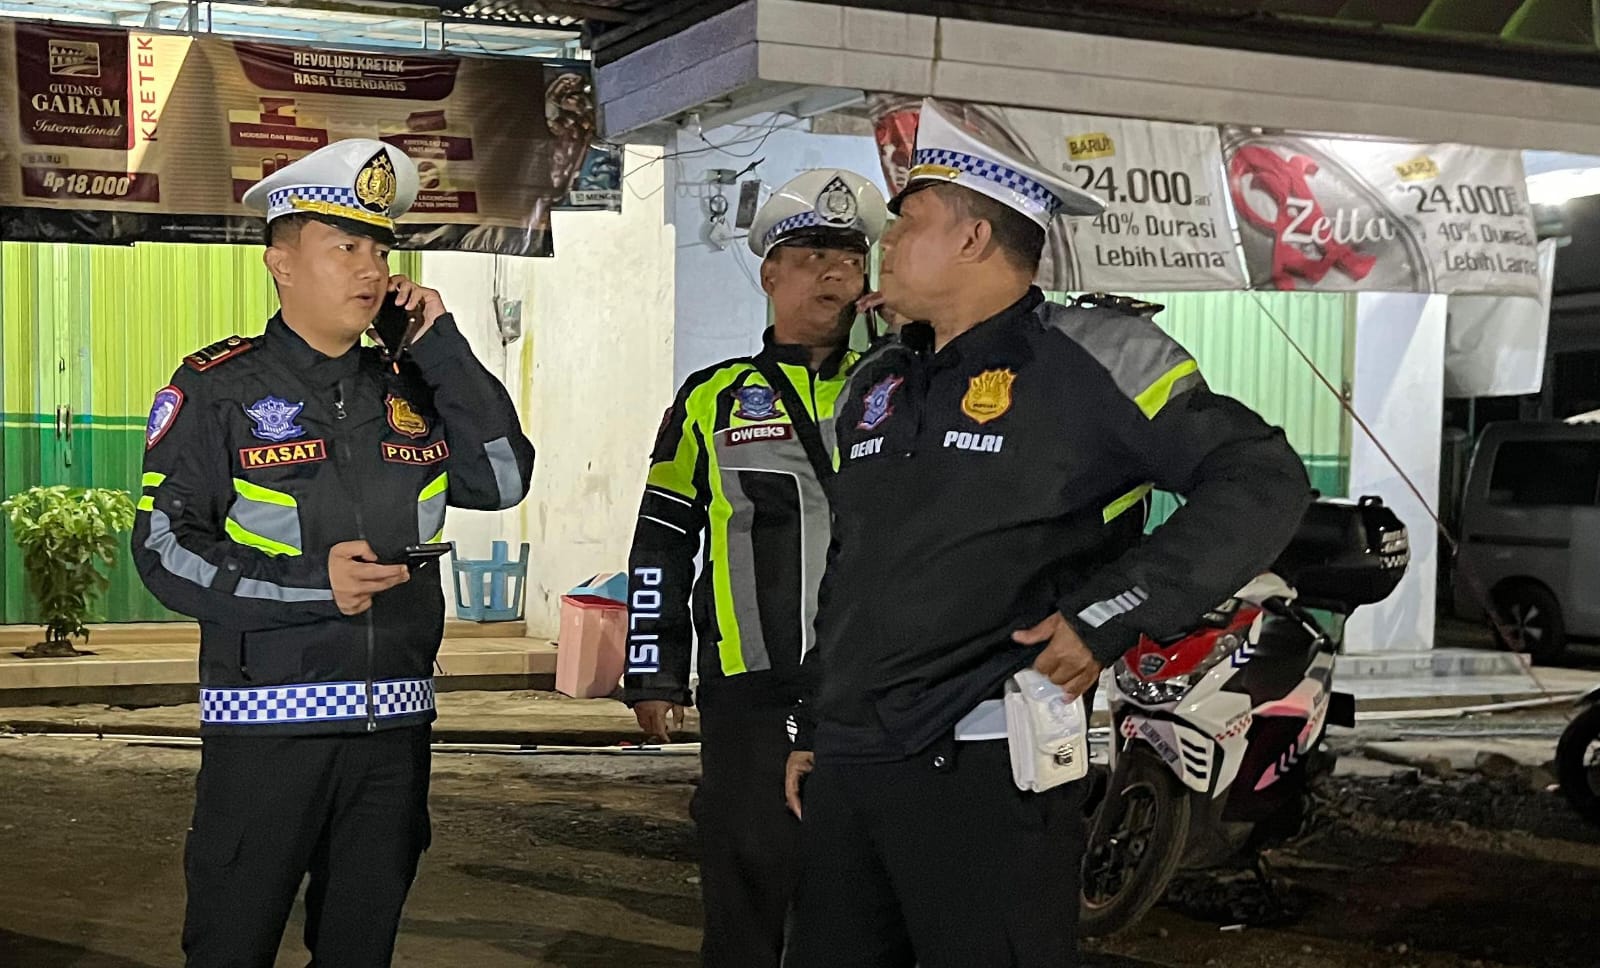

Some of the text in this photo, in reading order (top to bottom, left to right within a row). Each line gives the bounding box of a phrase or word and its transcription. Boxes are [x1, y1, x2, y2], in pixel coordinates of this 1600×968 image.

[293, 52, 404, 72] REVOLUSI KRETEK
[49, 83, 102, 96] GUDANG
[137, 37, 158, 141] KRETEK
[294, 73, 407, 91] RASA LEGENDARIS
[31, 93, 121, 117] GARAM
[32, 119, 123, 137] International
[1074, 164, 1192, 206] 24.000
[1092, 212, 1217, 238] 40% Durasi
[1096, 245, 1156, 267] Lebih
[731, 426, 785, 442] DWEEKS
[944, 430, 1003, 453] POLRI
[248, 443, 318, 465] KASAT
[386, 445, 442, 461] POLRI
[850, 436, 885, 459] DENY
[628, 567, 662, 673] POLISI
